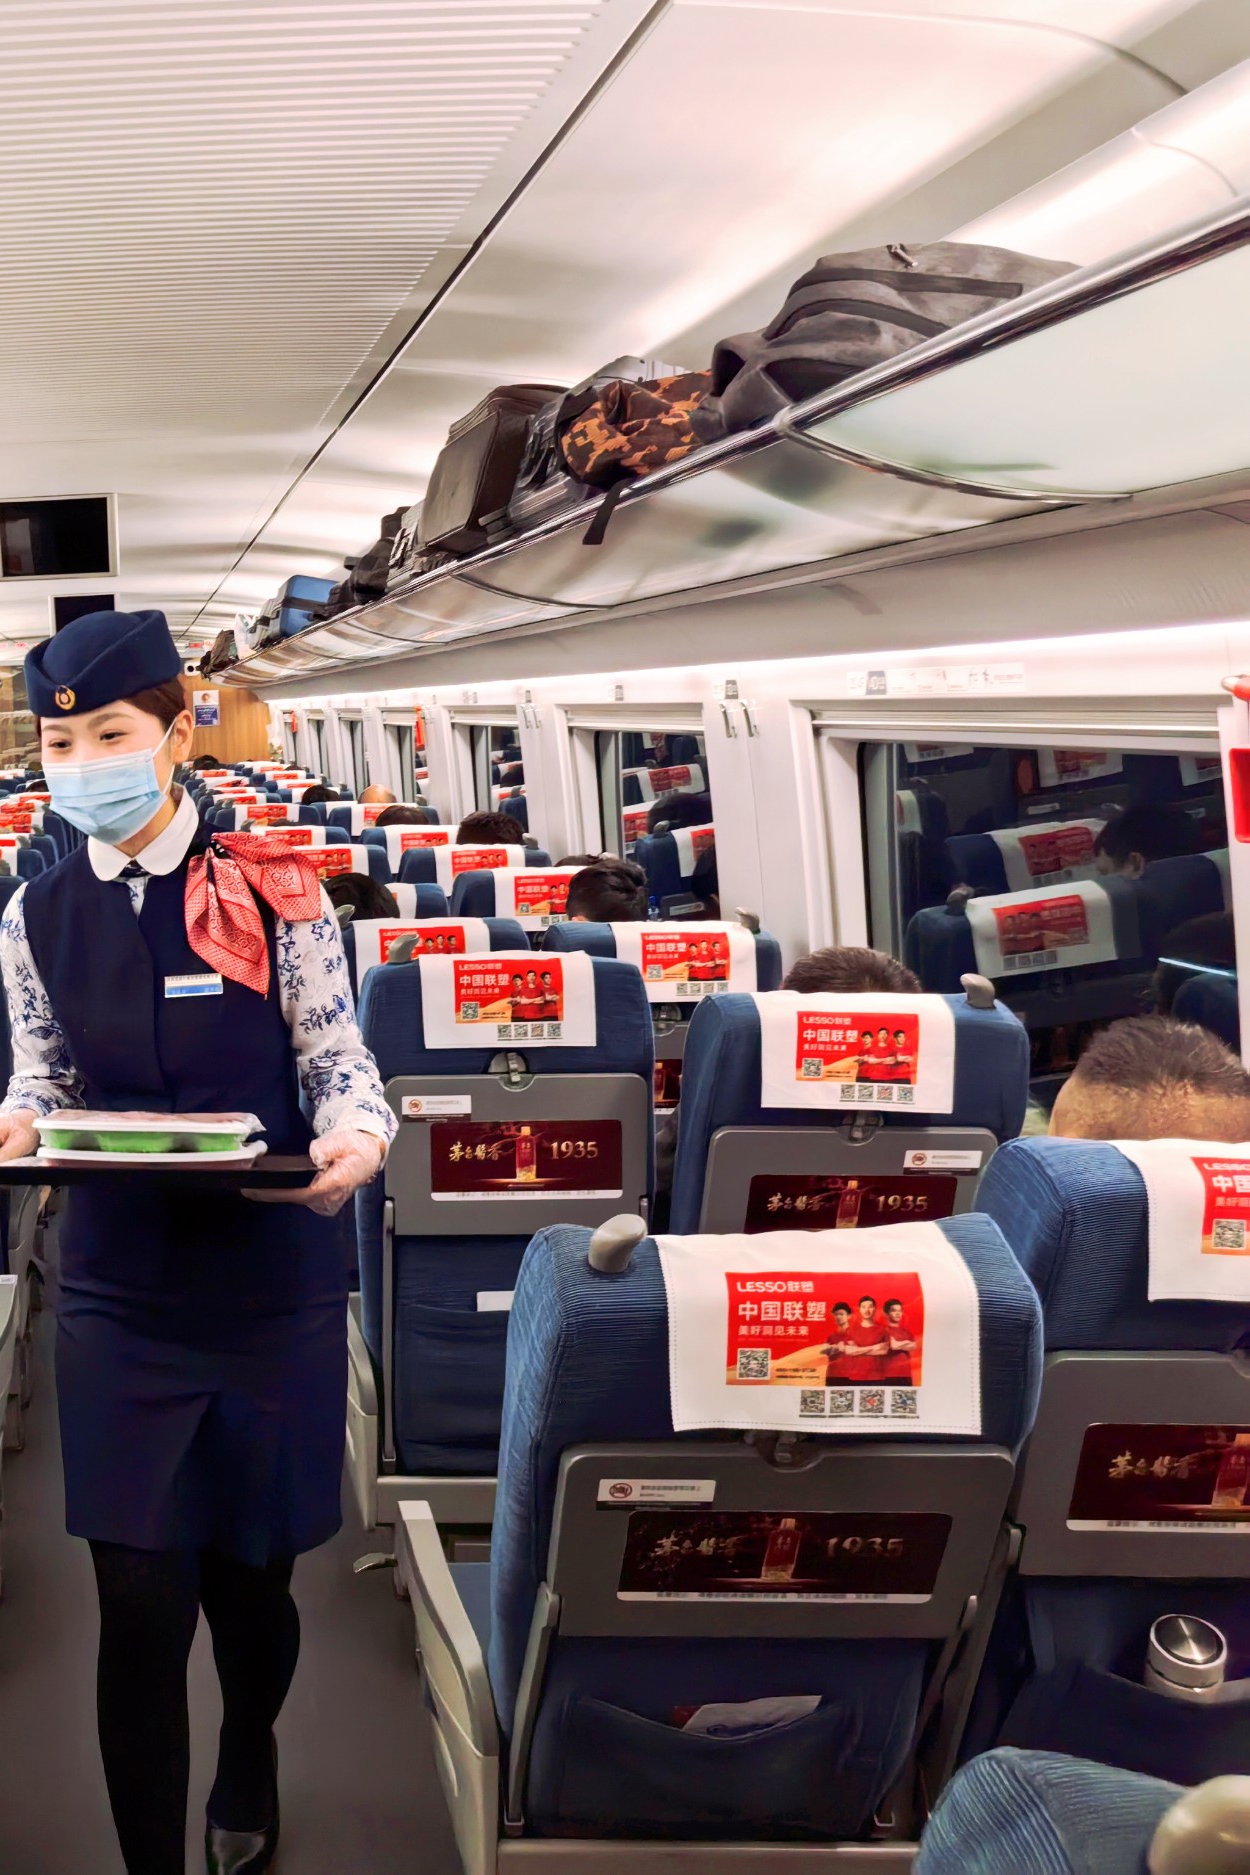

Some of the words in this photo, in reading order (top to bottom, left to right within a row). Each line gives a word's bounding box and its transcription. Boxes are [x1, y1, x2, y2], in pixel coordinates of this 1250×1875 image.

[803, 1028, 859, 1042] 中国联塑
[550, 1140, 599, 1160] 1935
[876, 1195, 928, 1212] 1935
[738, 1301, 827, 1322] 中国联塑
[825, 1535, 904, 1558] 1935
